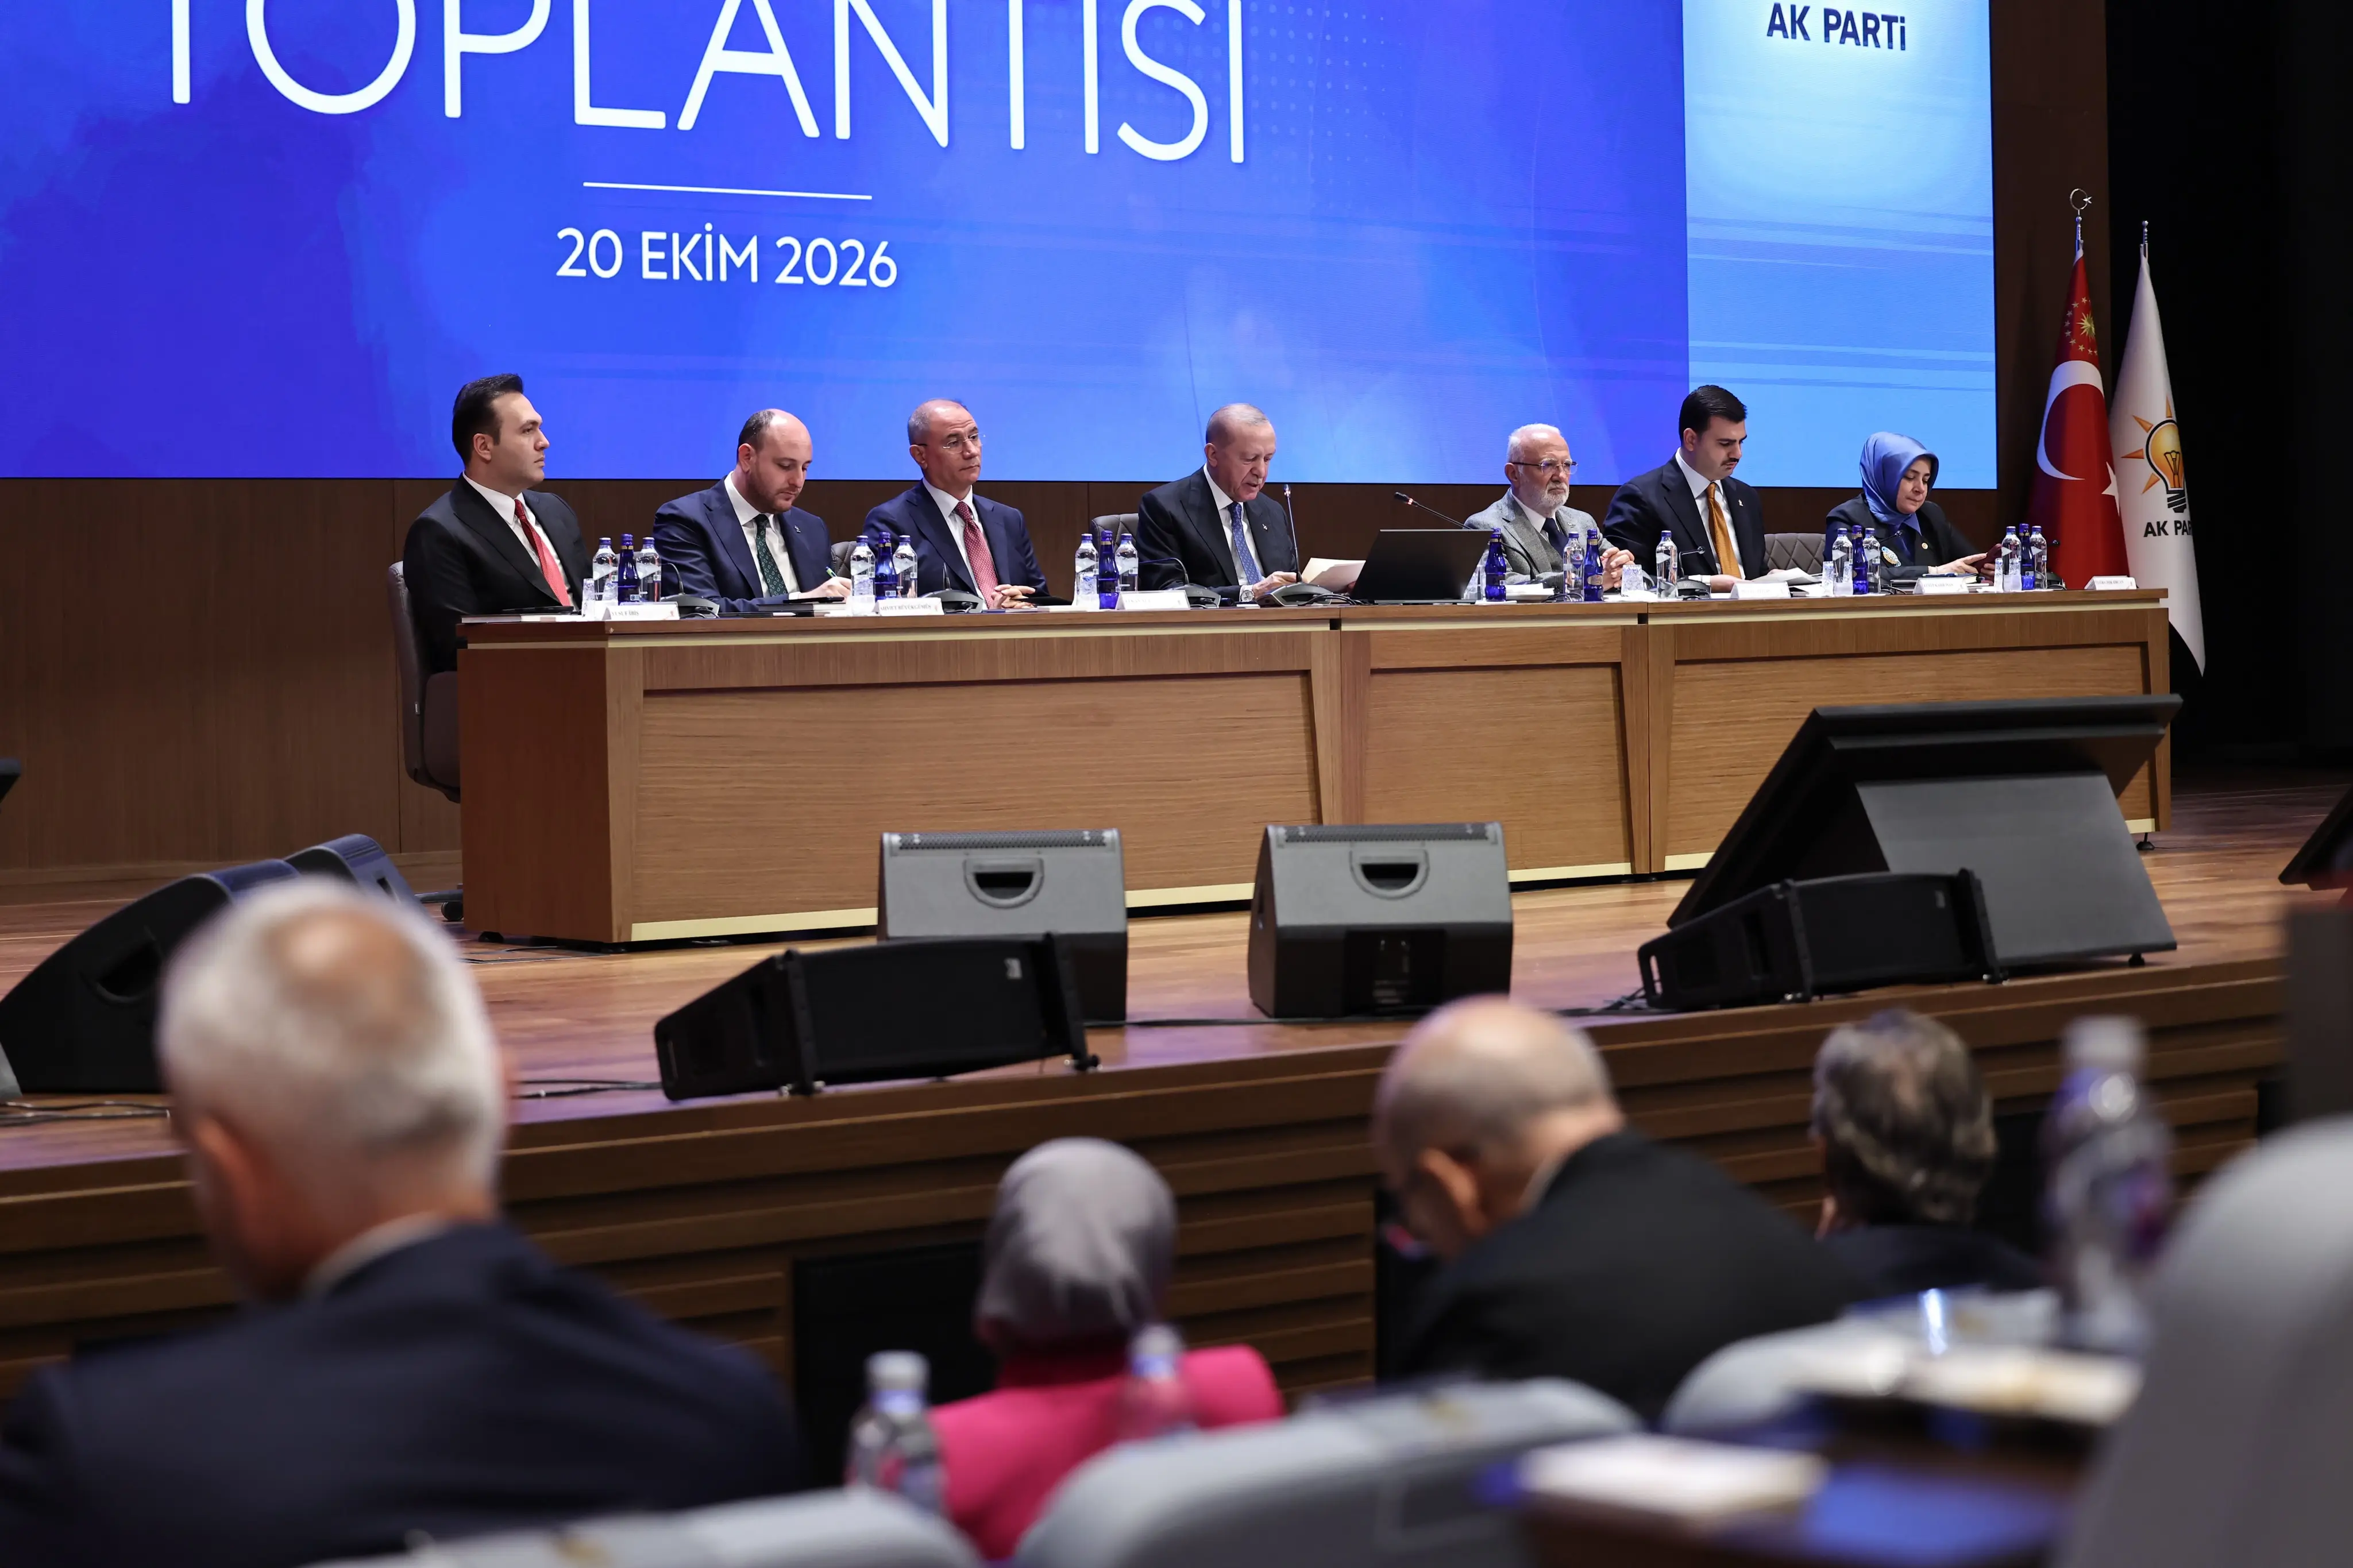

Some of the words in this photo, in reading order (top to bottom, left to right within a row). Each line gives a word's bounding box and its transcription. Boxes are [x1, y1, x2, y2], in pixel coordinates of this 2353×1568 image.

[1767, 2, 1811, 41] AK
[556, 227, 623, 278] 20
[642, 222, 758, 283] EKİM
[775, 236, 897, 288] 2026
[2143, 520, 2169, 538] AK
